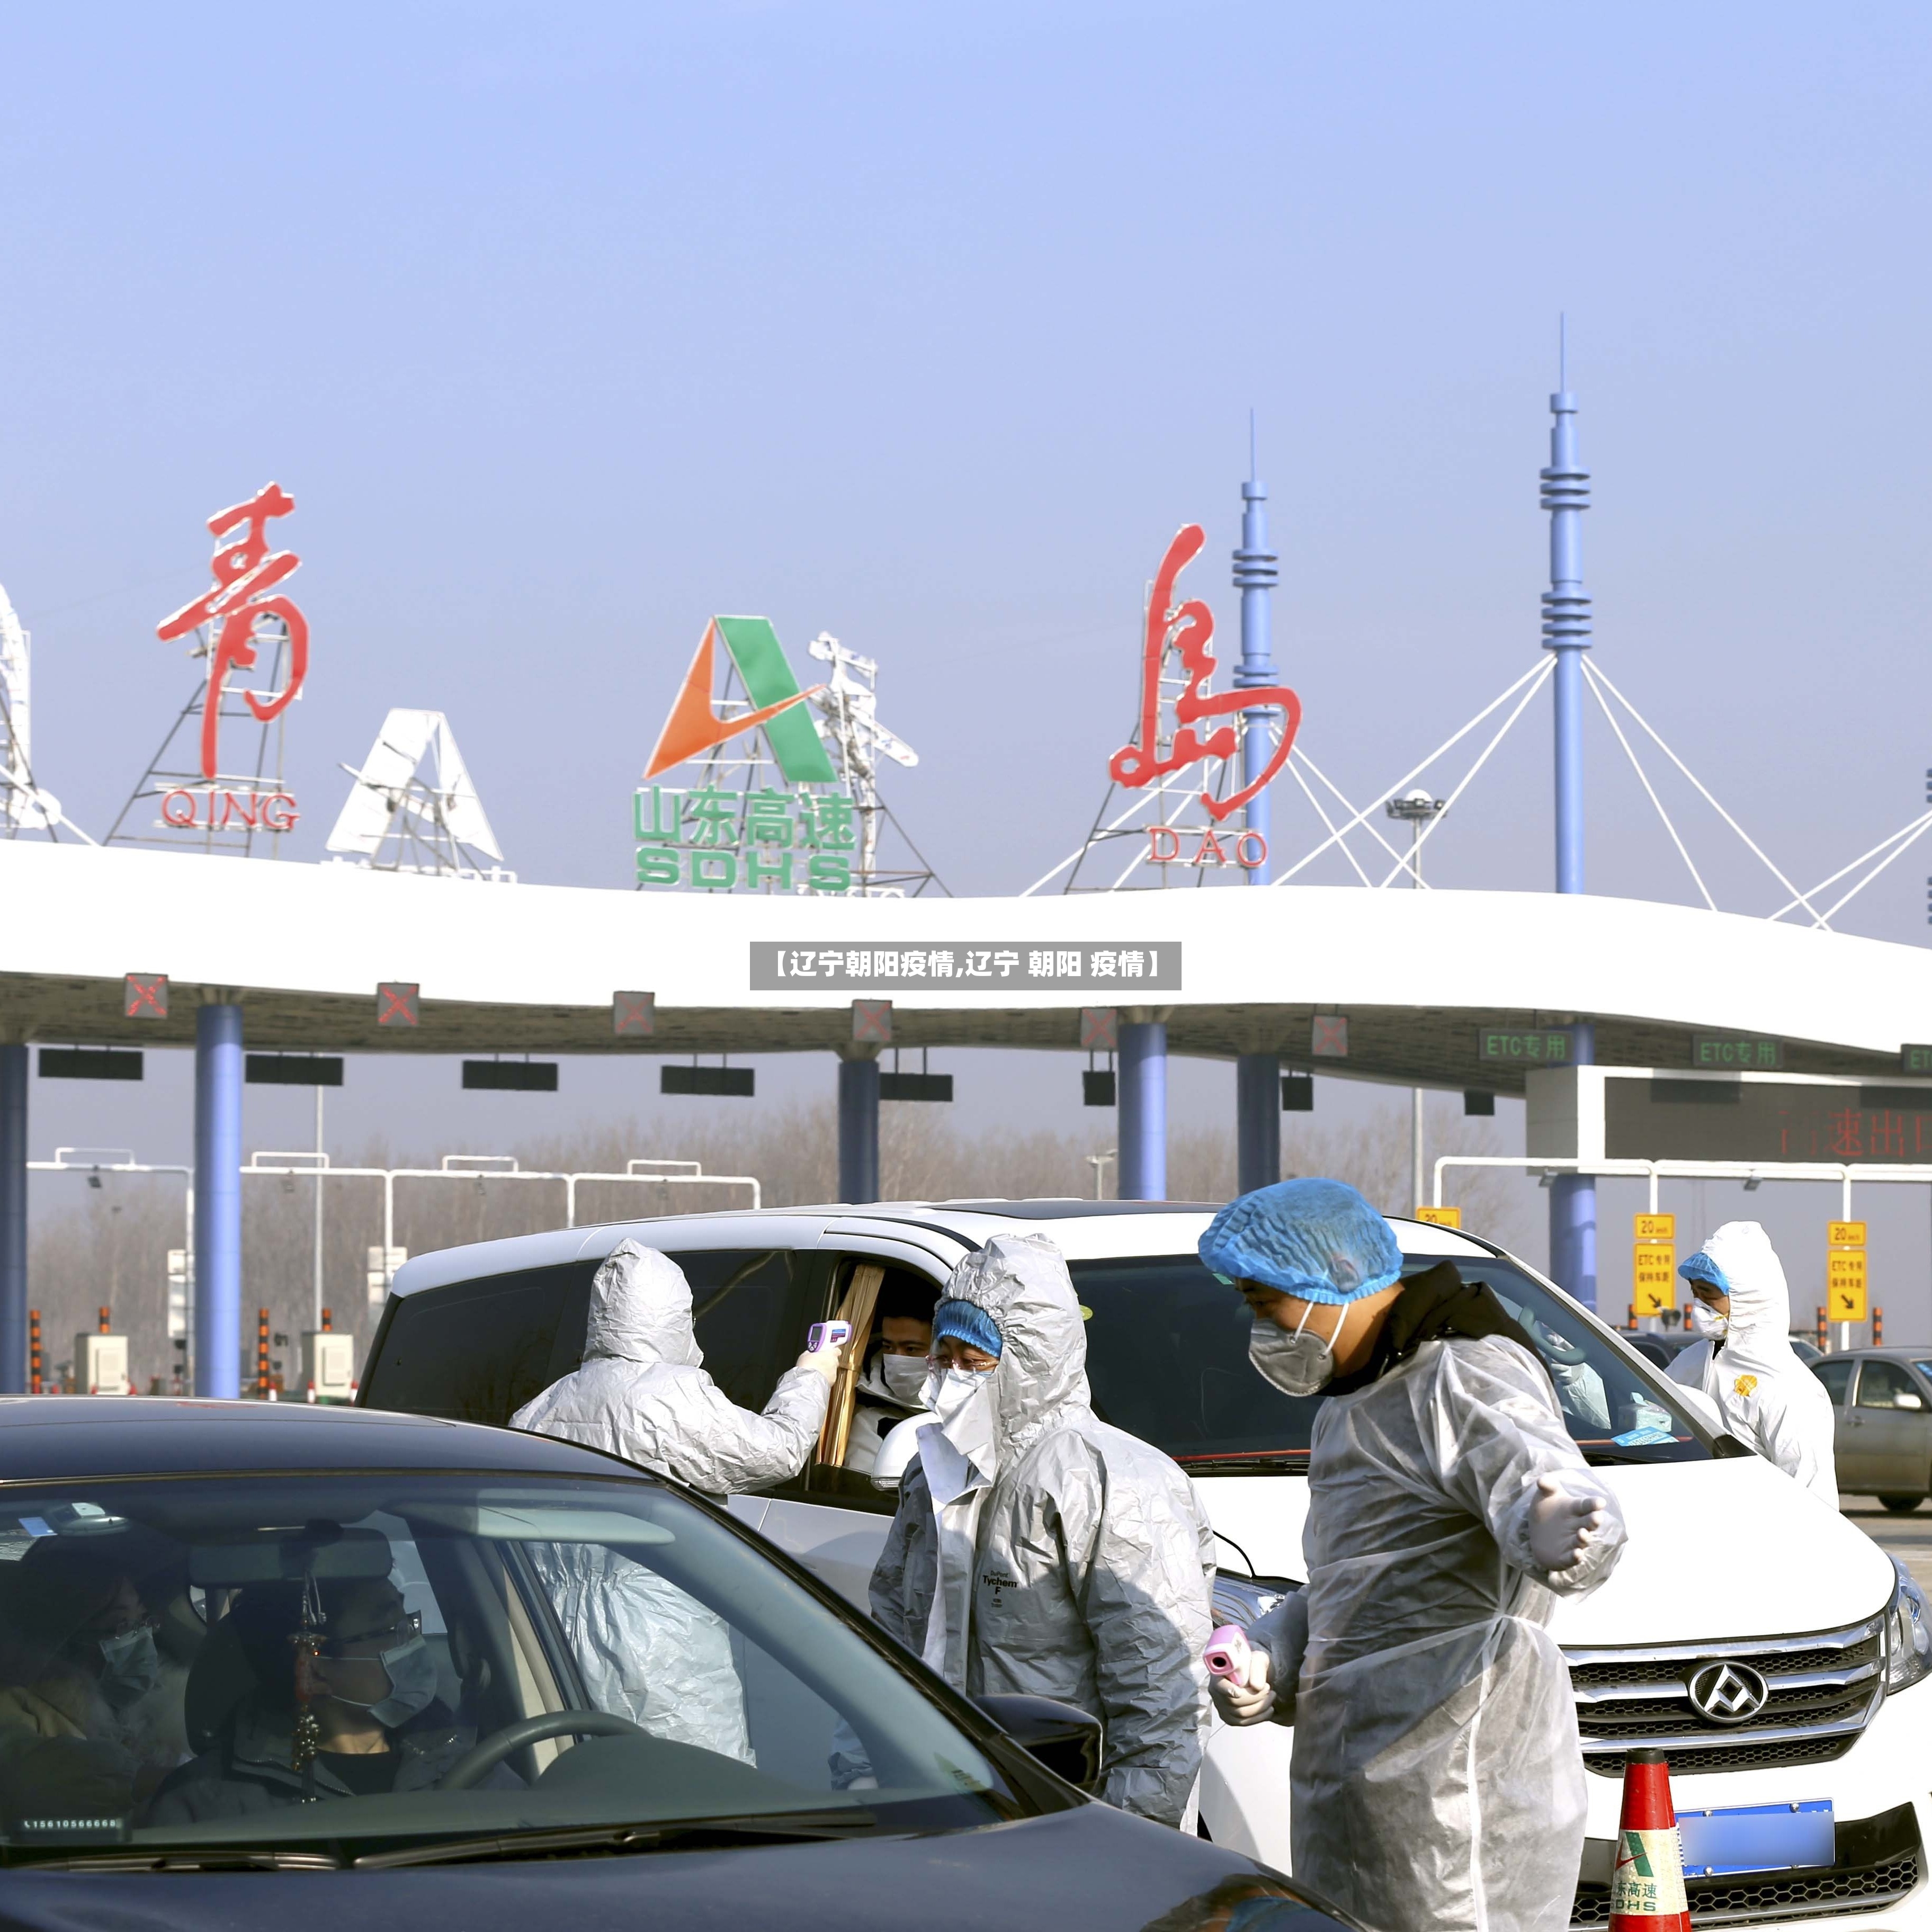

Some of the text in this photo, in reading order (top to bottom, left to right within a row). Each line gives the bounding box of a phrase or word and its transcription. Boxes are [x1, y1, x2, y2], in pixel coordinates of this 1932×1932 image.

[157, 484, 309, 780] 青
[162, 789, 300, 830] QING
[634, 784, 856, 851] 山东高速
[1148, 826, 1267, 867] DAO
[636, 846, 853, 892] SDHS
[1641, 1220, 1654, 1234] 20
[1835, 1227, 1846, 1241] 20
[982, 1575, 1017, 1588] Tychem
[995, 1587, 1001, 1595] F
[1613, 1881, 1658, 1899] 东高速
